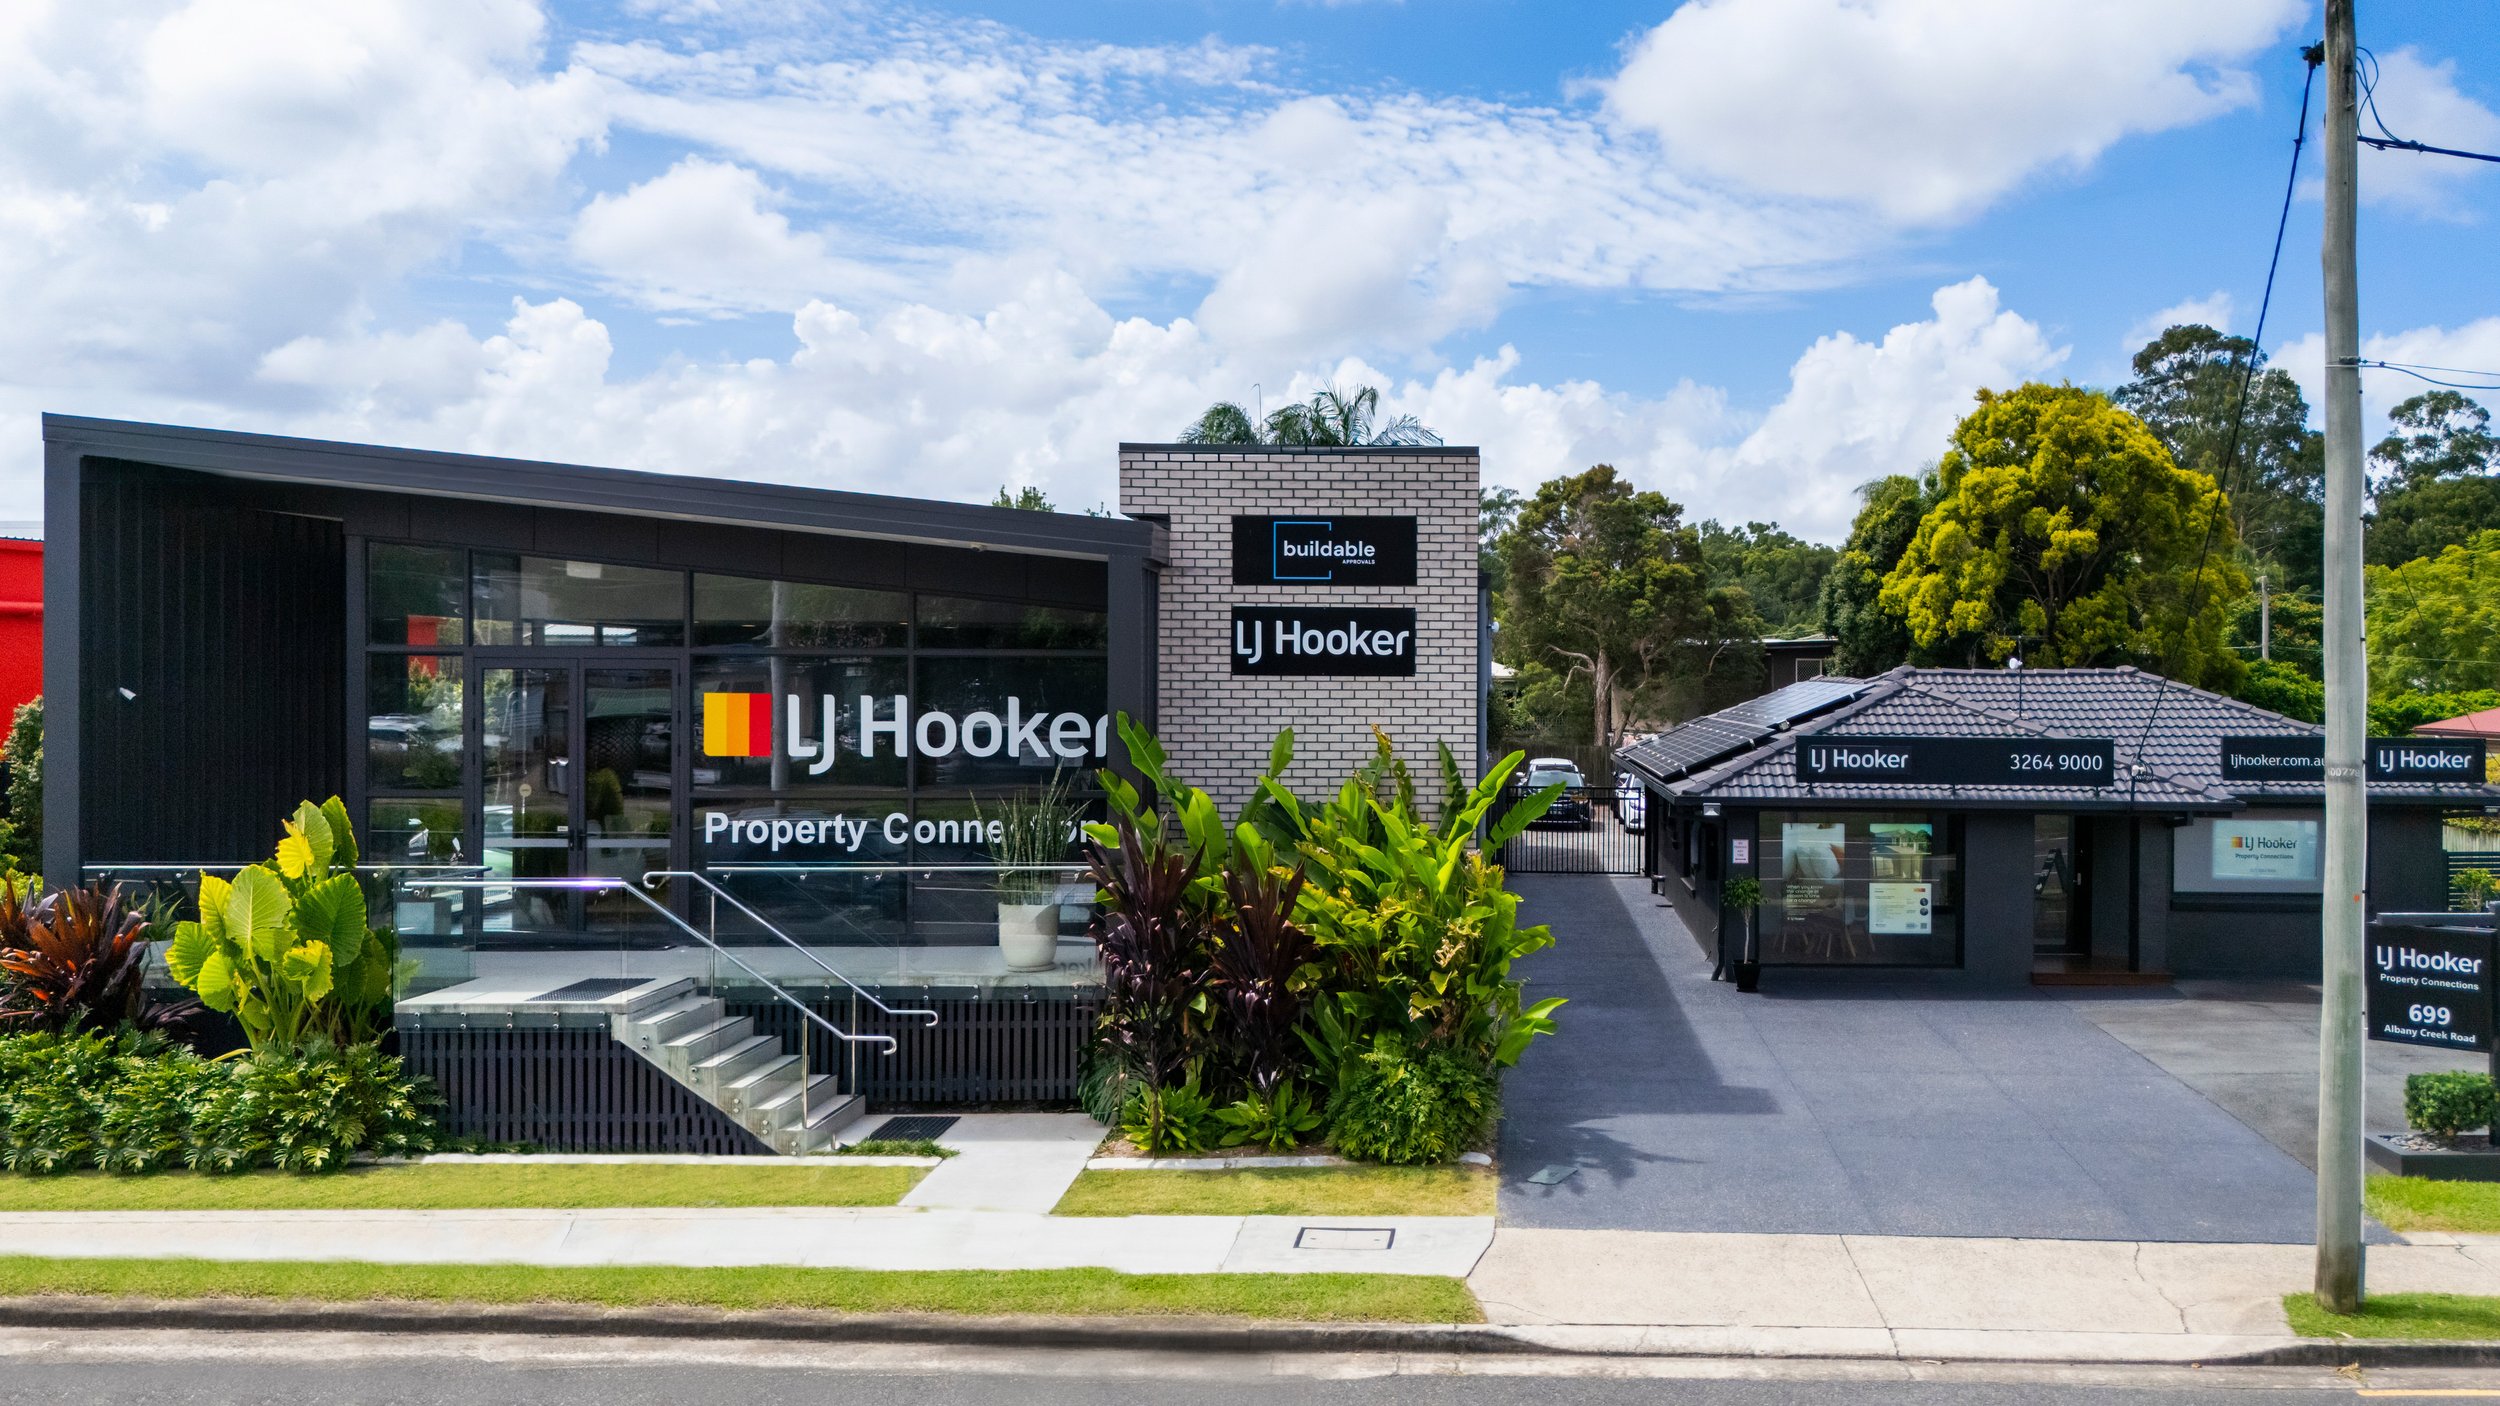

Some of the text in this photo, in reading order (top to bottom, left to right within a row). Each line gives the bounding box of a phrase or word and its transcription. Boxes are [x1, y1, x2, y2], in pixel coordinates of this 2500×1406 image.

[1283, 540, 1376, 557] buildable
[1236, 620, 1410, 664] LJ Hooker
[787, 694, 836, 775] LJ
[1811, 748, 1910, 773] LJ Hooker
[2010, 754, 2103, 771] 3264 9000
[2379, 749, 2472, 773] LJ Hooker
[705, 812, 868, 852] Property
[2245, 836, 2297, 851] LJ Hooker
[2377, 945, 2482, 974] LJ Hooker
[2380, 973, 2480, 991] Property Connections
[2408, 1004, 2451, 1026] 699
[2384, 1024, 2477, 1043] Albany Creek Road
